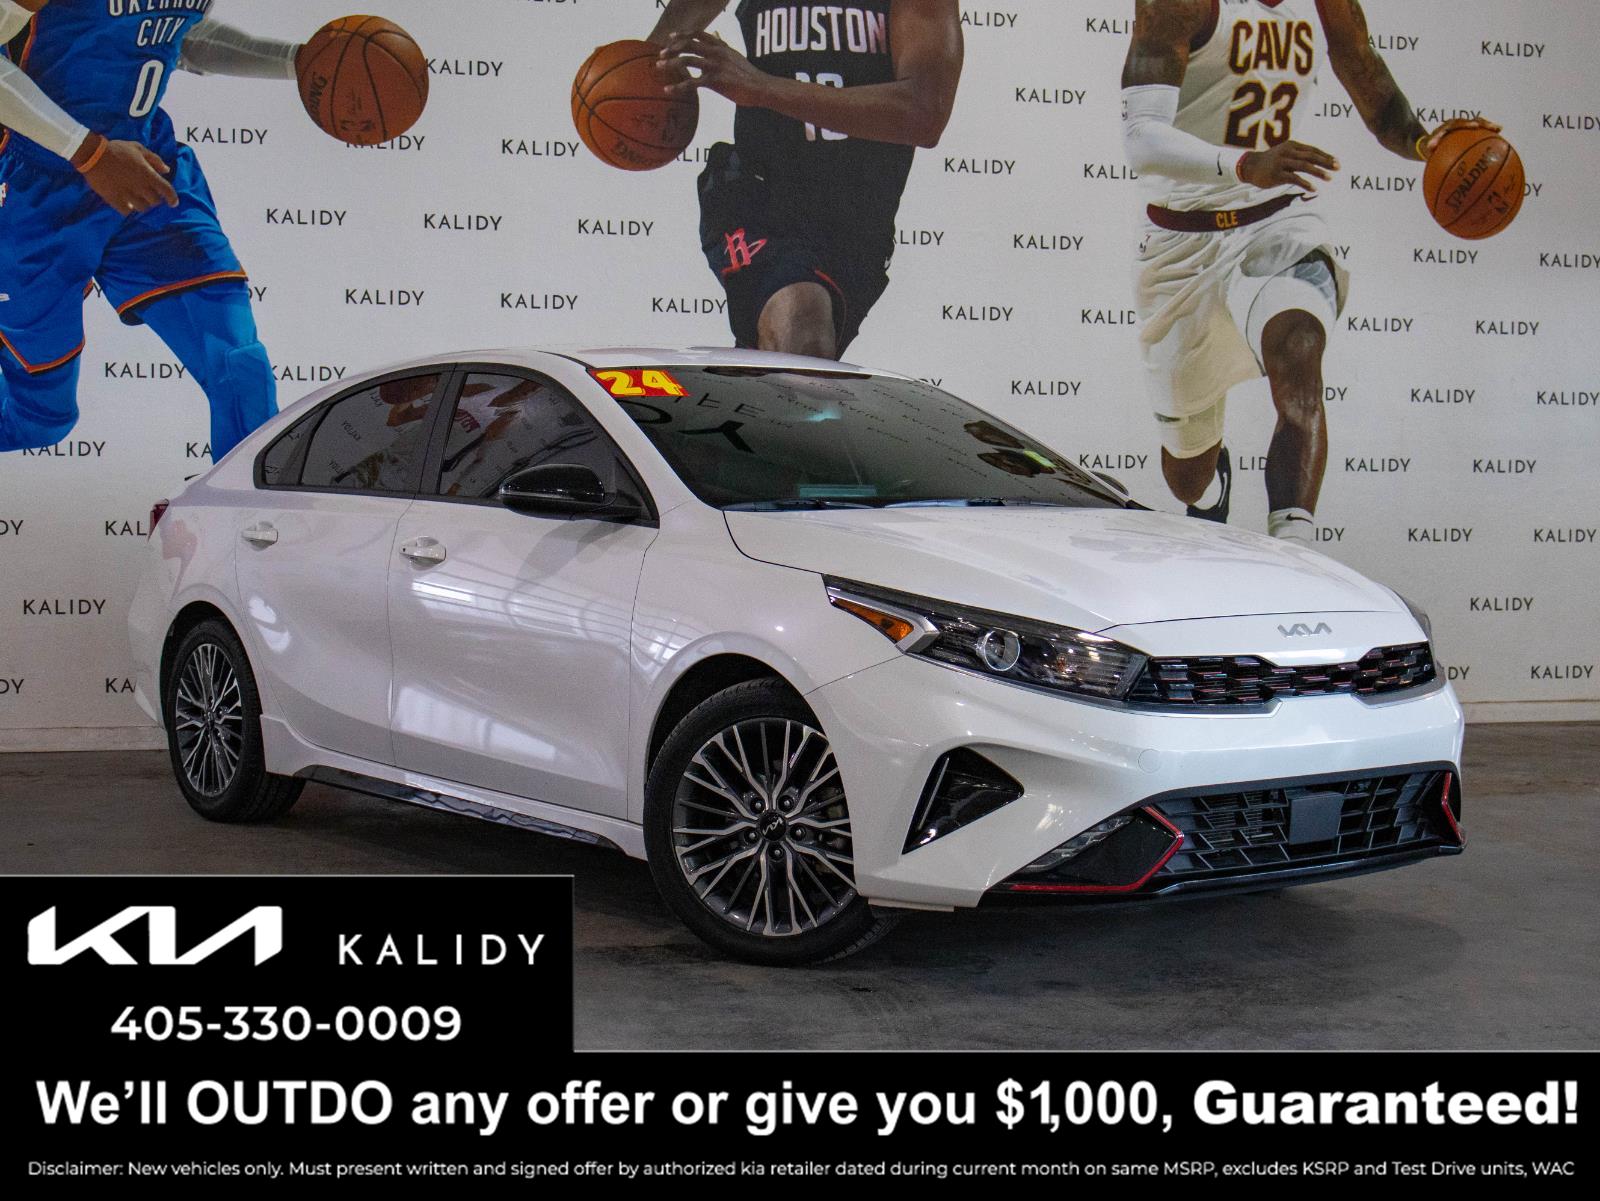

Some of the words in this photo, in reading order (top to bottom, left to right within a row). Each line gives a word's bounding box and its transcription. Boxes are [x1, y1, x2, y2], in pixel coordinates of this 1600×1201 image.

[960, 11, 1018, 28] ALIDY
[1086, 18, 1136, 34] KALI
[136, 16, 186, 47] CITY
[756, 5, 887, 58] HOUSTON
[1228, 18, 1315, 77] CAVS
[1367, 35, 1420, 51] ALIDY
[1481, 41, 1545, 58] KALIDY
[426, 58, 503, 77] KALIDY
[129, 59, 165, 118] 0
[1016, 87, 1085, 105] KALIDY
[1223, 79, 1299, 150] 23
[1315, 103, 1353, 118] IDY
[187, 127, 268, 144] KALIDY
[502, 139, 580, 157] KALIDY
[945, 158, 1015, 175] KALIDY
[1084, 163, 1138, 180] KALI
[1351, 176, 1416, 192] KALIDY
[266, 208, 346, 226] KALIDY
[424, 213, 502, 231] KALIDY
[1215, 211, 1240, 229] CLE
[578, 219, 654, 236] KALIDY
[894, 230, 944, 246] LIDY
[1013, 234, 1084, 250] KALIDY
[1413, 248, 1478, 264] KALIDY
[1539, 253, 1600, 268] KALIDY
[345, 289, 424, 306] KALIDY
[501, 293, 578, 310] KALIDY
[652, 297, 727, 314] KALIDY
[942, 305, 1013, 321] KALIDY
[1081, 309, 1136, 325] KALID
[1348, 317, 1413, 332] KALIDY
[1475, 320, 1539, 336] KALIDY
[105, 362, 186, 379] KALIDY
[595, 369, 684, 397] 24
[1011, 380, 1082, 396] KALIDY
[1411, 388, 1475, 404] KALIDY
[1537, 391, 1600, 406] KALIDY
[1079, 454, 1148, 470] KALIDY
[1239, 456, 1268, 471] LID
[1345, 457, 1410, 473] KALIDY
[1473, 459, 1537, 474] KALIDY
[105, 520, 149, 536] KAL
[1315, 527, 1345, 542] IDY
[1408, 528, 1473, 543] KALIDY
[1534, 528, 1597, 543] KALIDY
[23, 599, 106, 615] KALIDY
[1470, 597, 1534, 611] KALIDY
[1277, 621, 1333, 637] KIA
[1531, 665, 1593, 680] KALIDY
